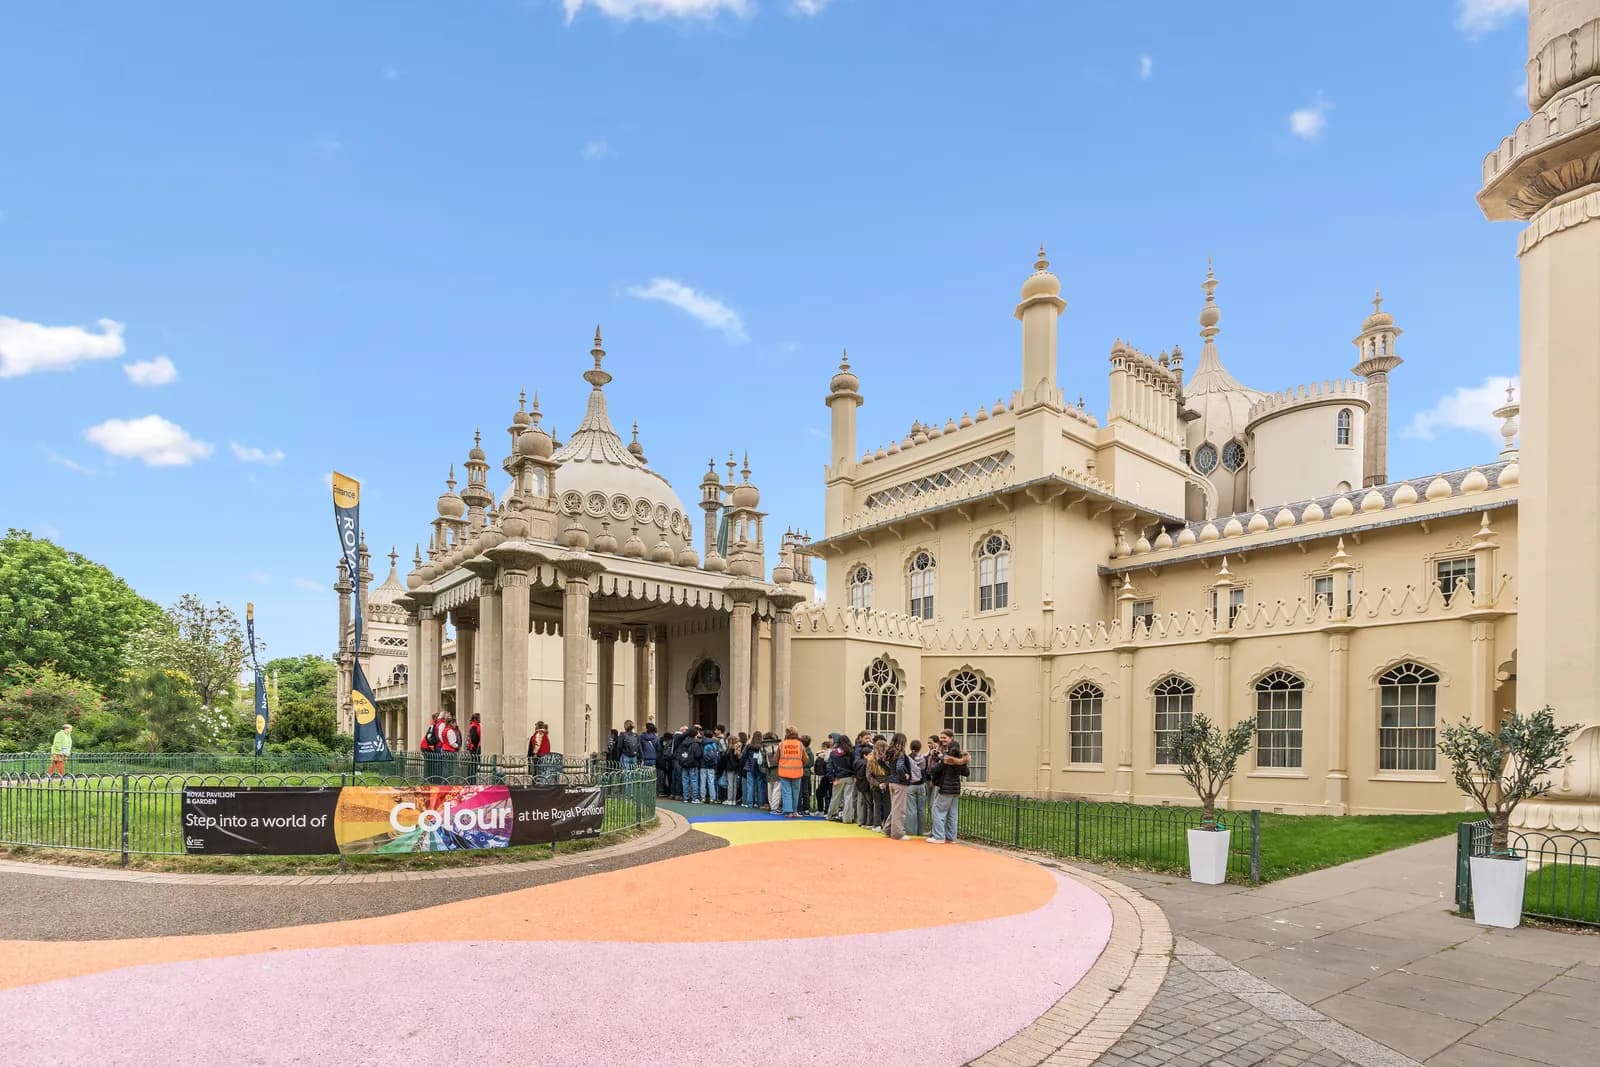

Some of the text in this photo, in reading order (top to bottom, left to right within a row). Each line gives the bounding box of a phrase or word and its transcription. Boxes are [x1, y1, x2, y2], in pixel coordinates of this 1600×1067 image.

[185, 813, 327, 829] Step into a world of
[390, 802, 512, 832] Colour
[518, 805, 604, 822] at the Royal Pavilion
